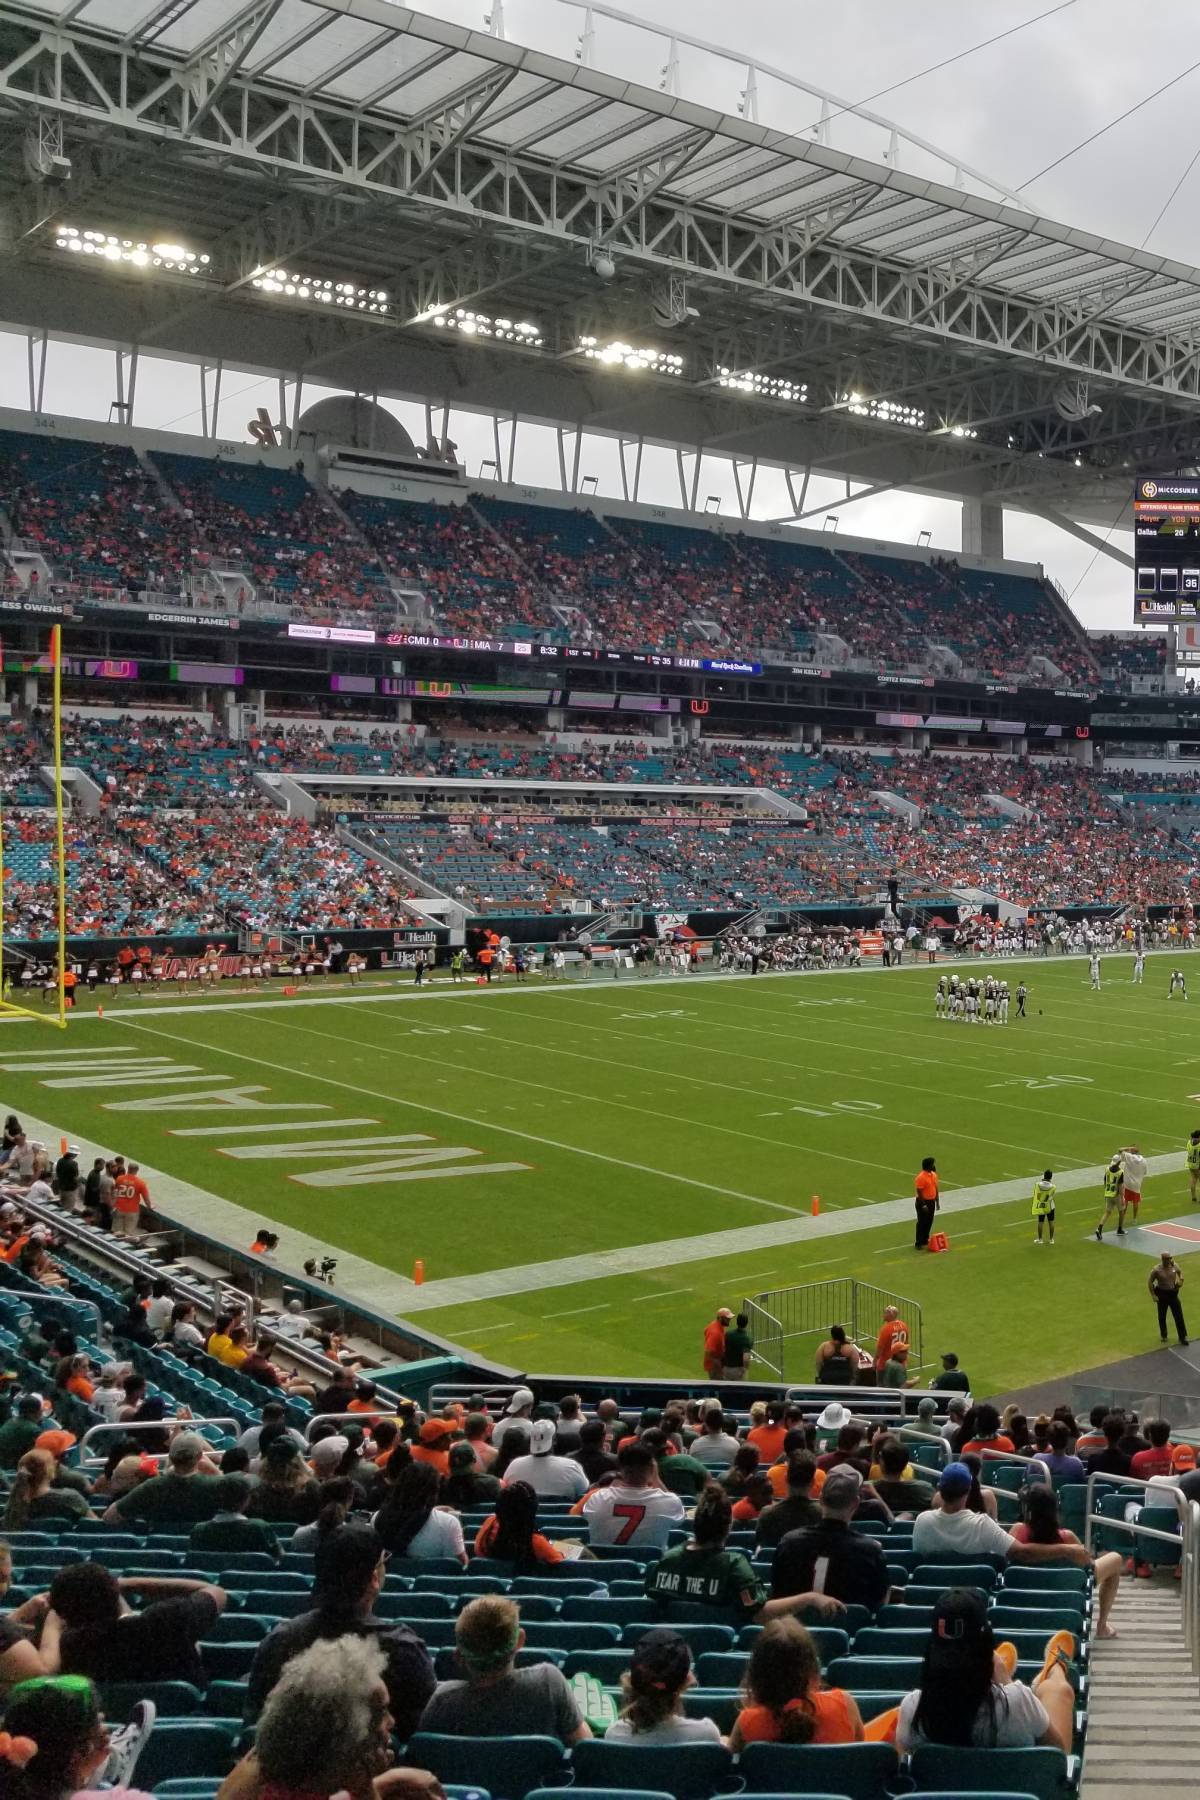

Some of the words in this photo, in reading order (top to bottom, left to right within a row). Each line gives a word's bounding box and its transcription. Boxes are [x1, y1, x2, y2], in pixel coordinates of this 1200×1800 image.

[23, 603, 63, 614] OWENS
[148, 613, 196, 624] EDGERRIN
[198, 616, 230, 626] JAMES
[407, 635, 429, 646] CMU
[474, 640, 491, 650] MIA
[498, 642, 504, 651] 7
[540, 646, 558, 656] 8:32
[804, 668, 821, 676] KELLY
[877, 675, 898, 683] CORTEZ
[612, 1505, 645, 1545] 7
[813, 1556, 830, 1595] 1
[655, 1571, 680, 1592] FEAR
[686, 1576, 706, 1595] THE
[709, 1579, 719, 1596] U
